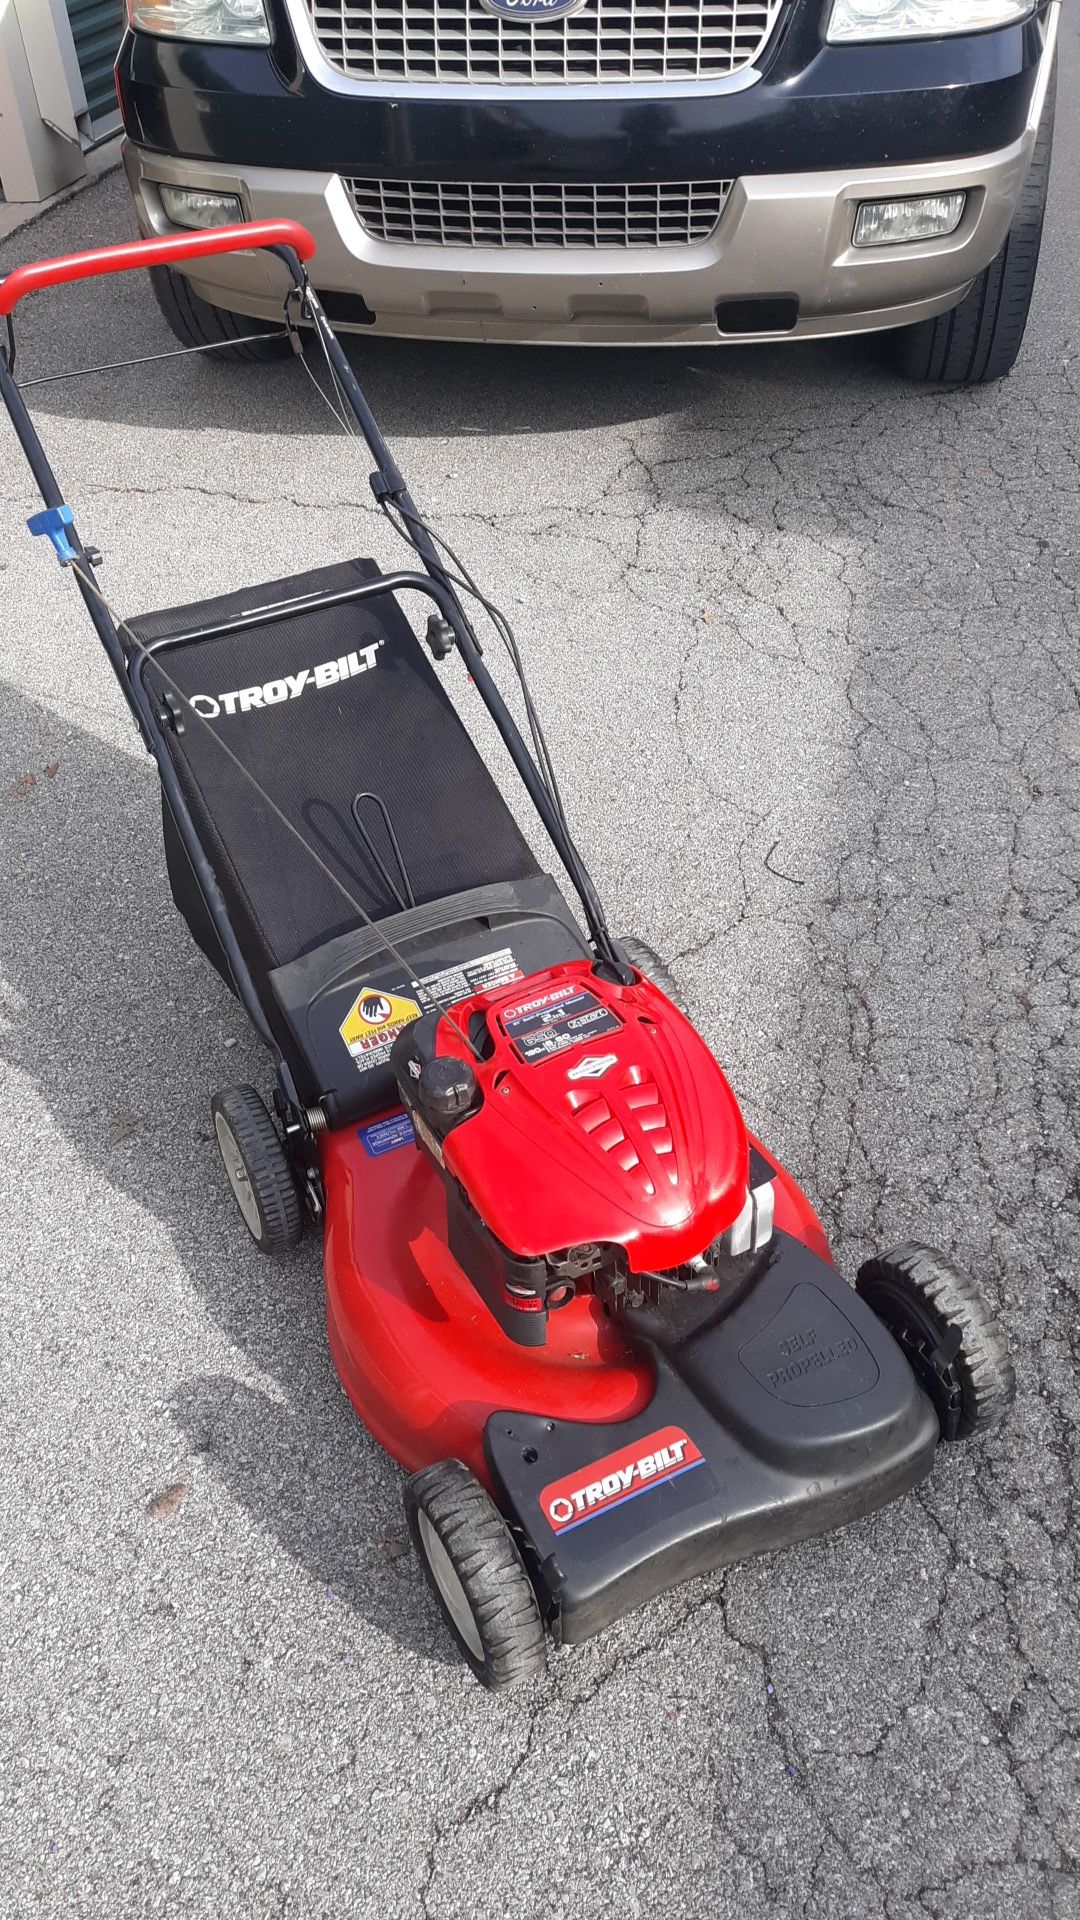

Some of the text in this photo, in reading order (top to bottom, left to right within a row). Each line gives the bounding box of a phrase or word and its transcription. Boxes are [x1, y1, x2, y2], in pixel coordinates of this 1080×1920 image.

[218, 642, 380, 715] TROY-BILT
[515, 985, 575, 1014] TROY-BILT
[766, 1337, 858, 1389] PROPELLED
[779, 1327, 817, 1356] SELF
[571, 1439, 684, 1511] TROY-BILT
